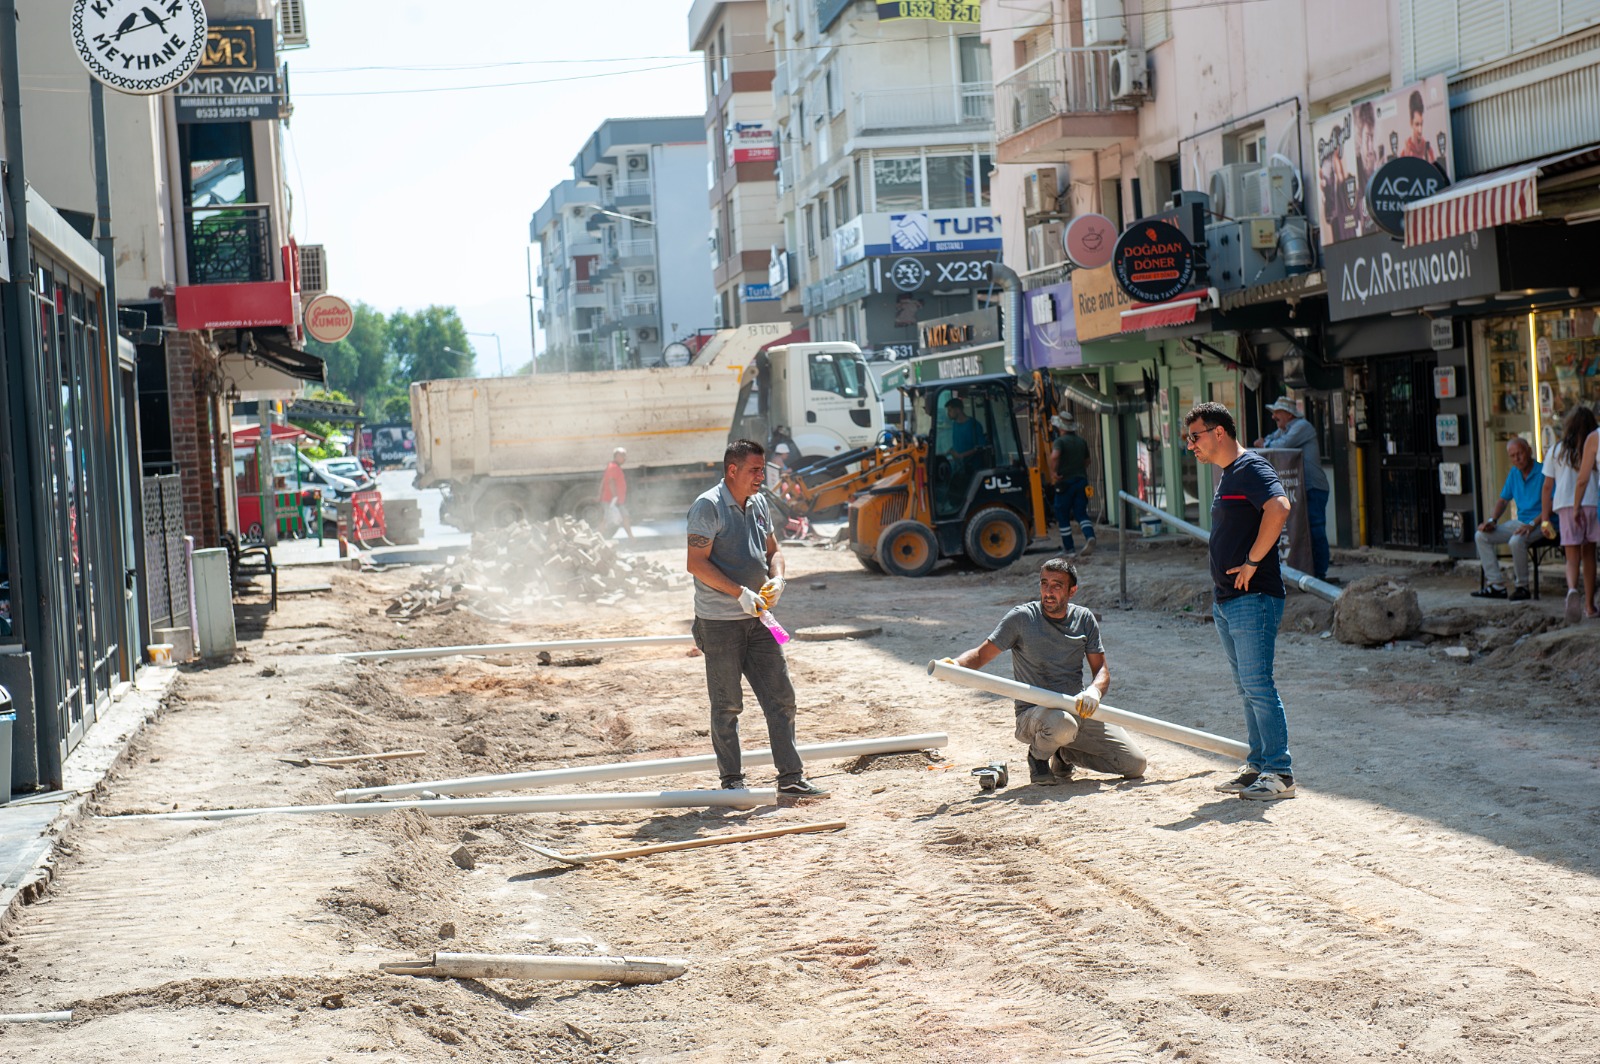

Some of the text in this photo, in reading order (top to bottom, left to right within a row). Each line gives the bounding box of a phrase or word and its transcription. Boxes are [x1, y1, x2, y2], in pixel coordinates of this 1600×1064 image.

[93, 33, 186, 70] MEYHANE
[178, 75, 274, 95] DMR YAPI
[1378, 177, 1438, 199] AÇAR
[1376, 201, 1406, 212] TEKN
[1124, 242, 1182, 257] DOĞADAN
[1133, 257, 1175, 271] DÖNER
[1078, 292, 1097, 316] Rice
[1098, 285, 1115, 311] and
[313, 305, 349, 317] Gastro
[311, 316, 349, 328] KUMRU
[760, 325, 779, 334] TON
